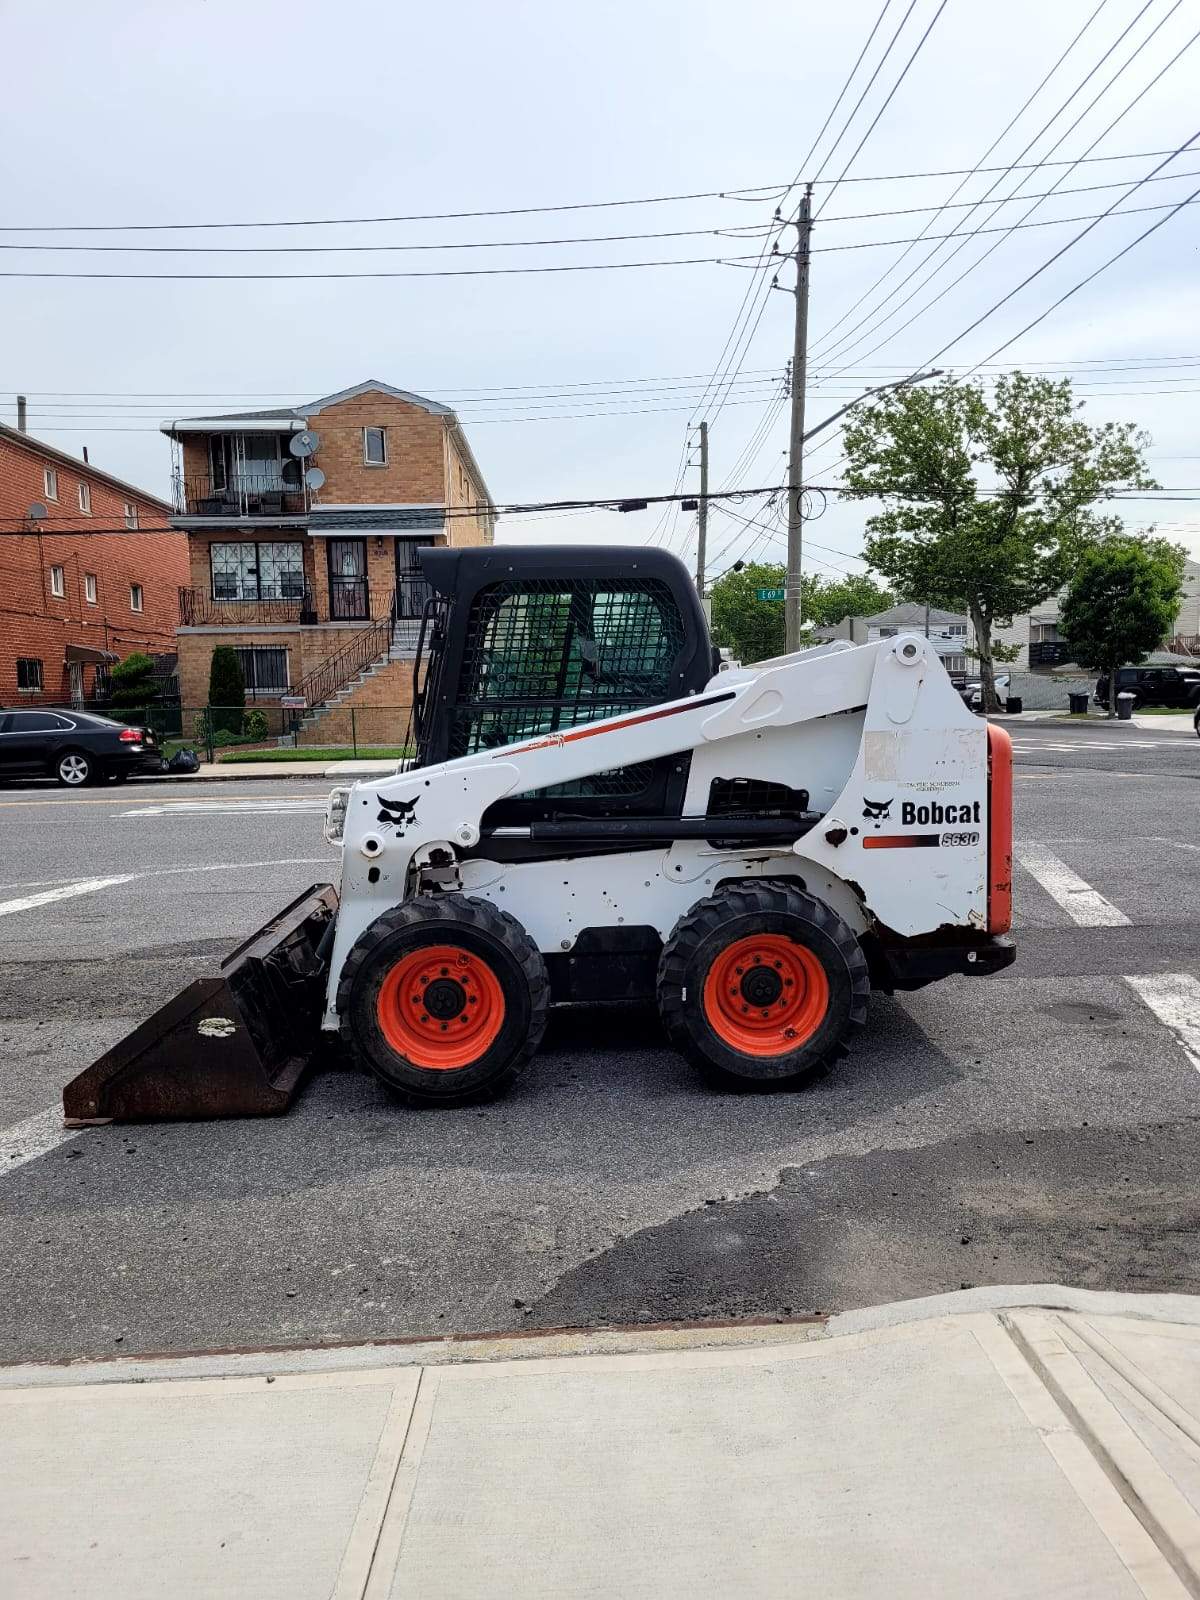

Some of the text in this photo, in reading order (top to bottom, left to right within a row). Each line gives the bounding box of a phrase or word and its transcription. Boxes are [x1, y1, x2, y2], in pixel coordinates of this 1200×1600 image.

[767, 590, 776, 599] 69
[902, 801, 981, 825] Bobcat
[942, 832, 980, 847] S630
